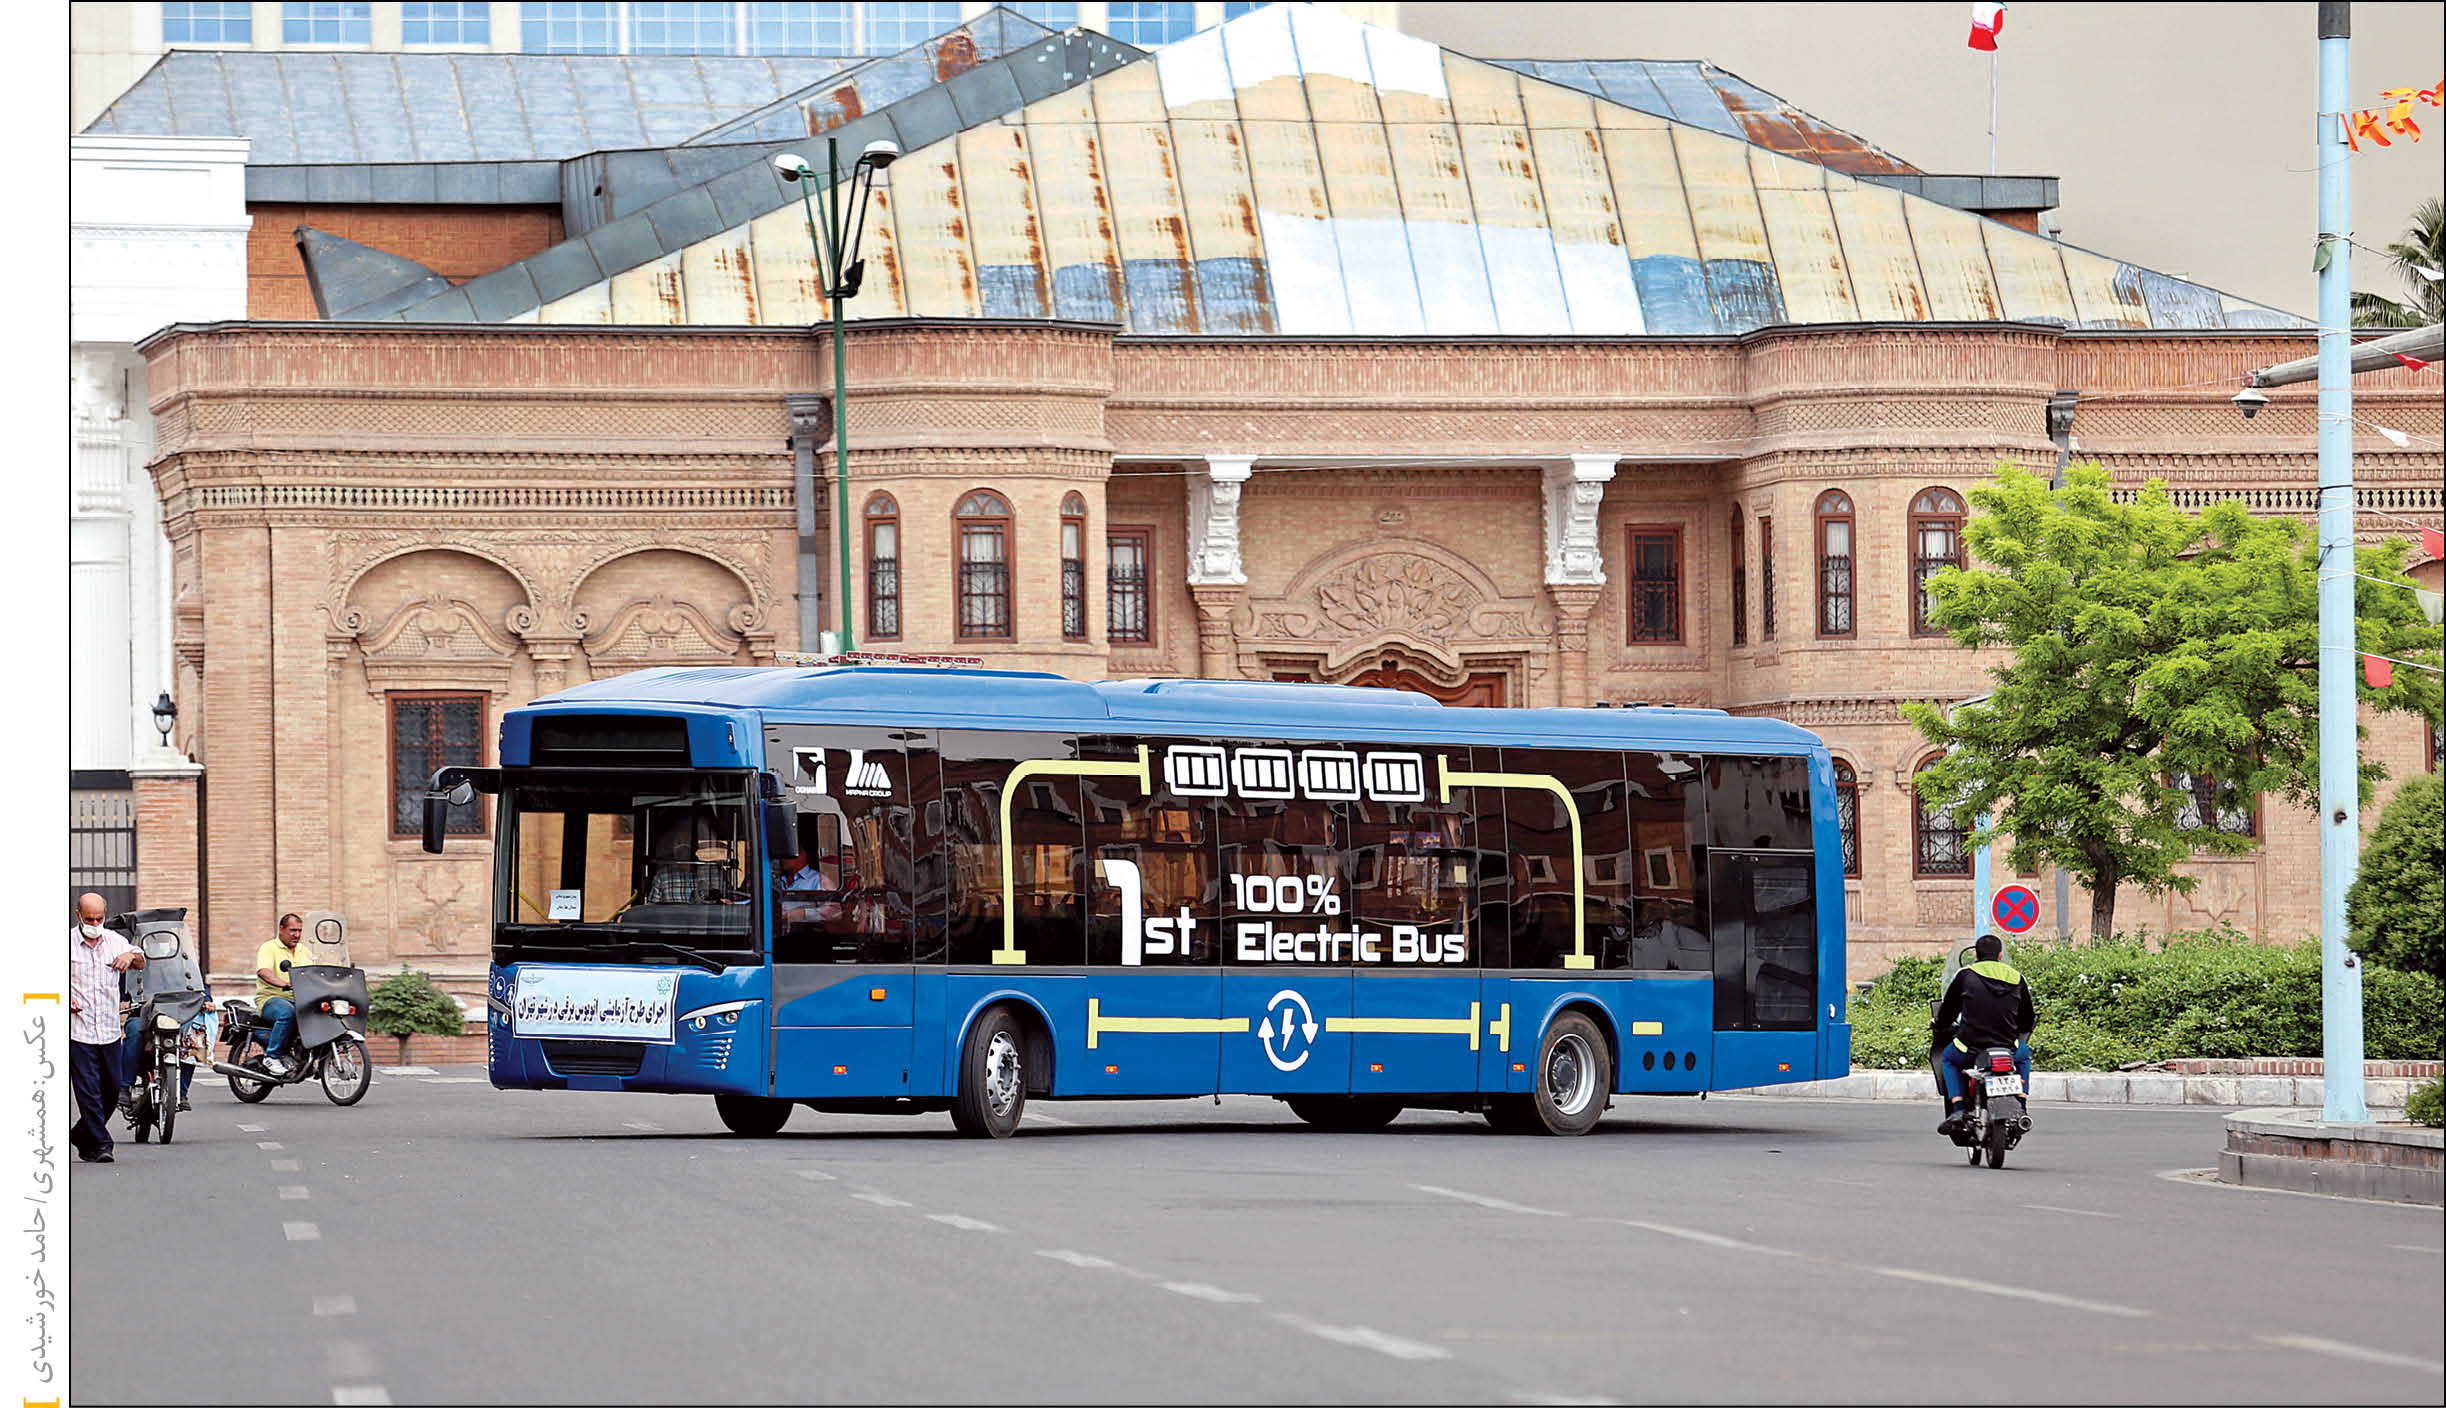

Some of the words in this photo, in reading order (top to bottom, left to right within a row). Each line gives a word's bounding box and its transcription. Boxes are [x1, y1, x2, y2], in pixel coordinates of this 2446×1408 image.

[1230, 873, 1342, 916] 100%
[1102, 858, 1197, 966] 1st
[1237, 920, 1382, 963] Electric
[1392, 925, 1467, 963] Bus
[518, 996, 536, 1020] تهران
[536, 995, 548, 1021] شهر
[547, 1000, 558, 1021] در
[558, 995, 575, 1021] برقی
[575, 998, 599, 1022] اتوبوس
[600, 996, 630, 1023] آزمایشی
[629, 999, 645, 1024] طرح
[645, 999, 667, 1025] اجرای
